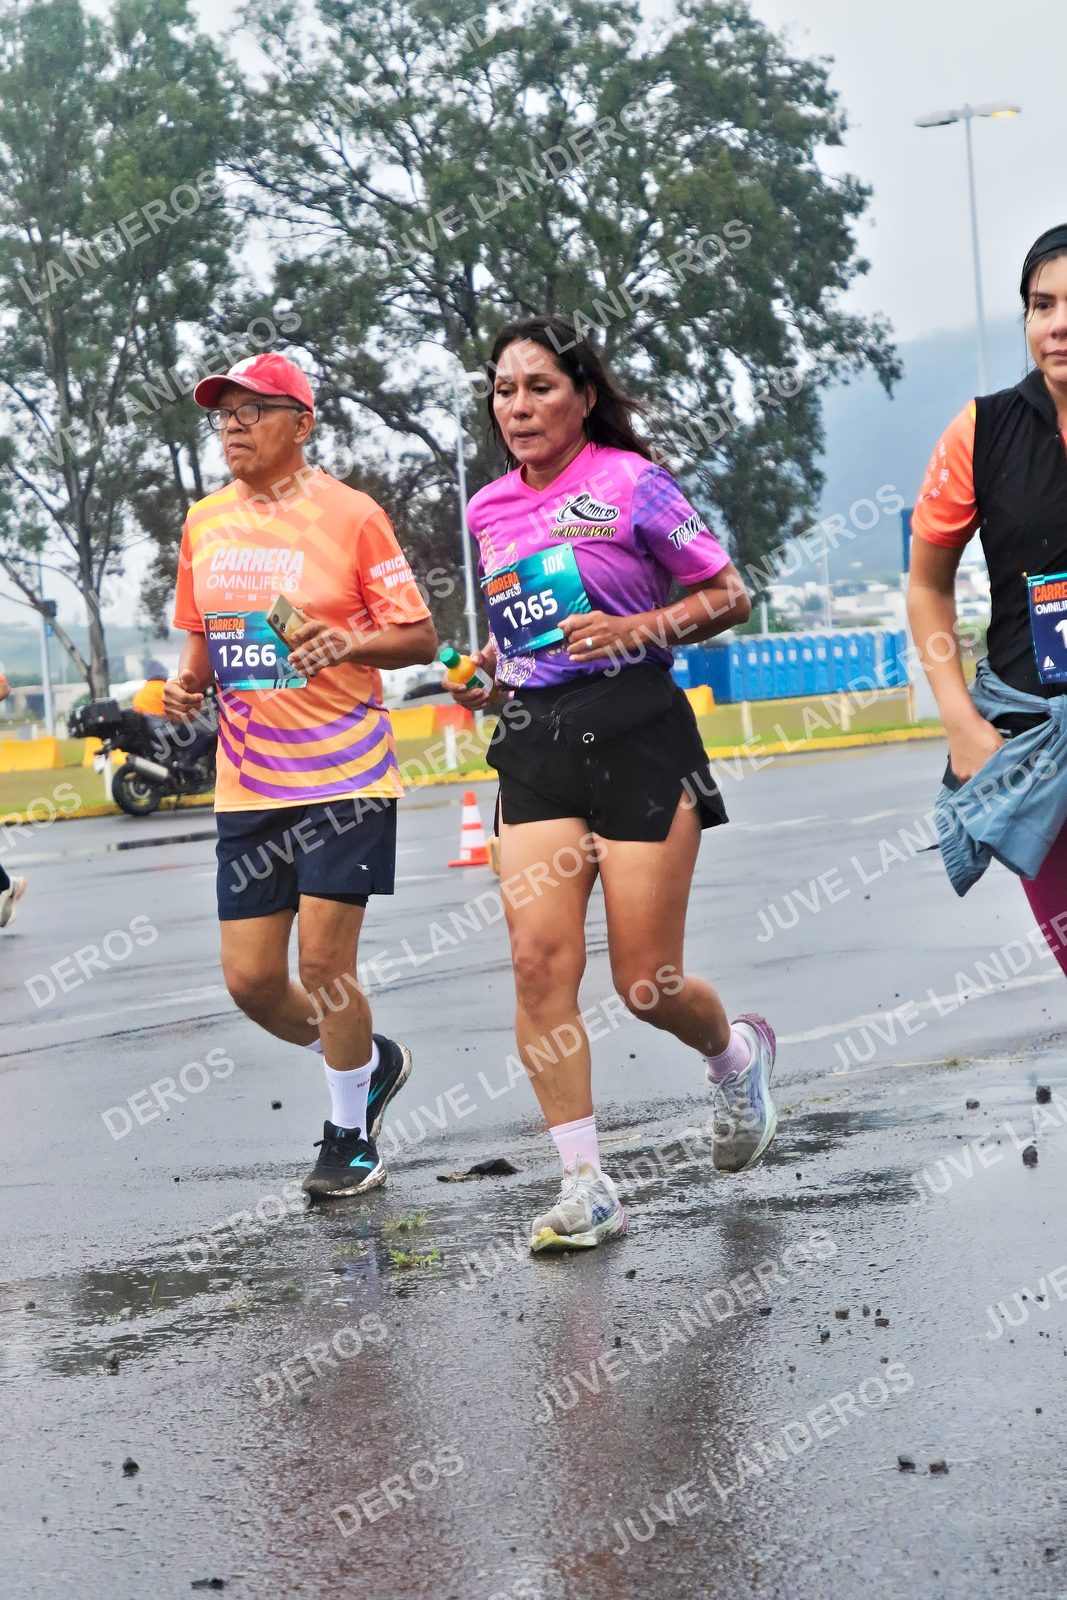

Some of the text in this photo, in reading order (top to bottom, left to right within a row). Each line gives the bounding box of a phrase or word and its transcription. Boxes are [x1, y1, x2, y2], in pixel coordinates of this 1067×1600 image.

[210, 547, 305, 576] CARRERA
[541, 553, 566, 576] 10K
[206, 573, 280, 591] OMNILIFE
[487, 571, 519, 597] CARRERA
[502, 588, 558, 629] 1265
[208, 618, 245, 632] CARRERA
[209, 630, 236, 640] OMNILIFE
[218, 644, 277, 667] 1266
